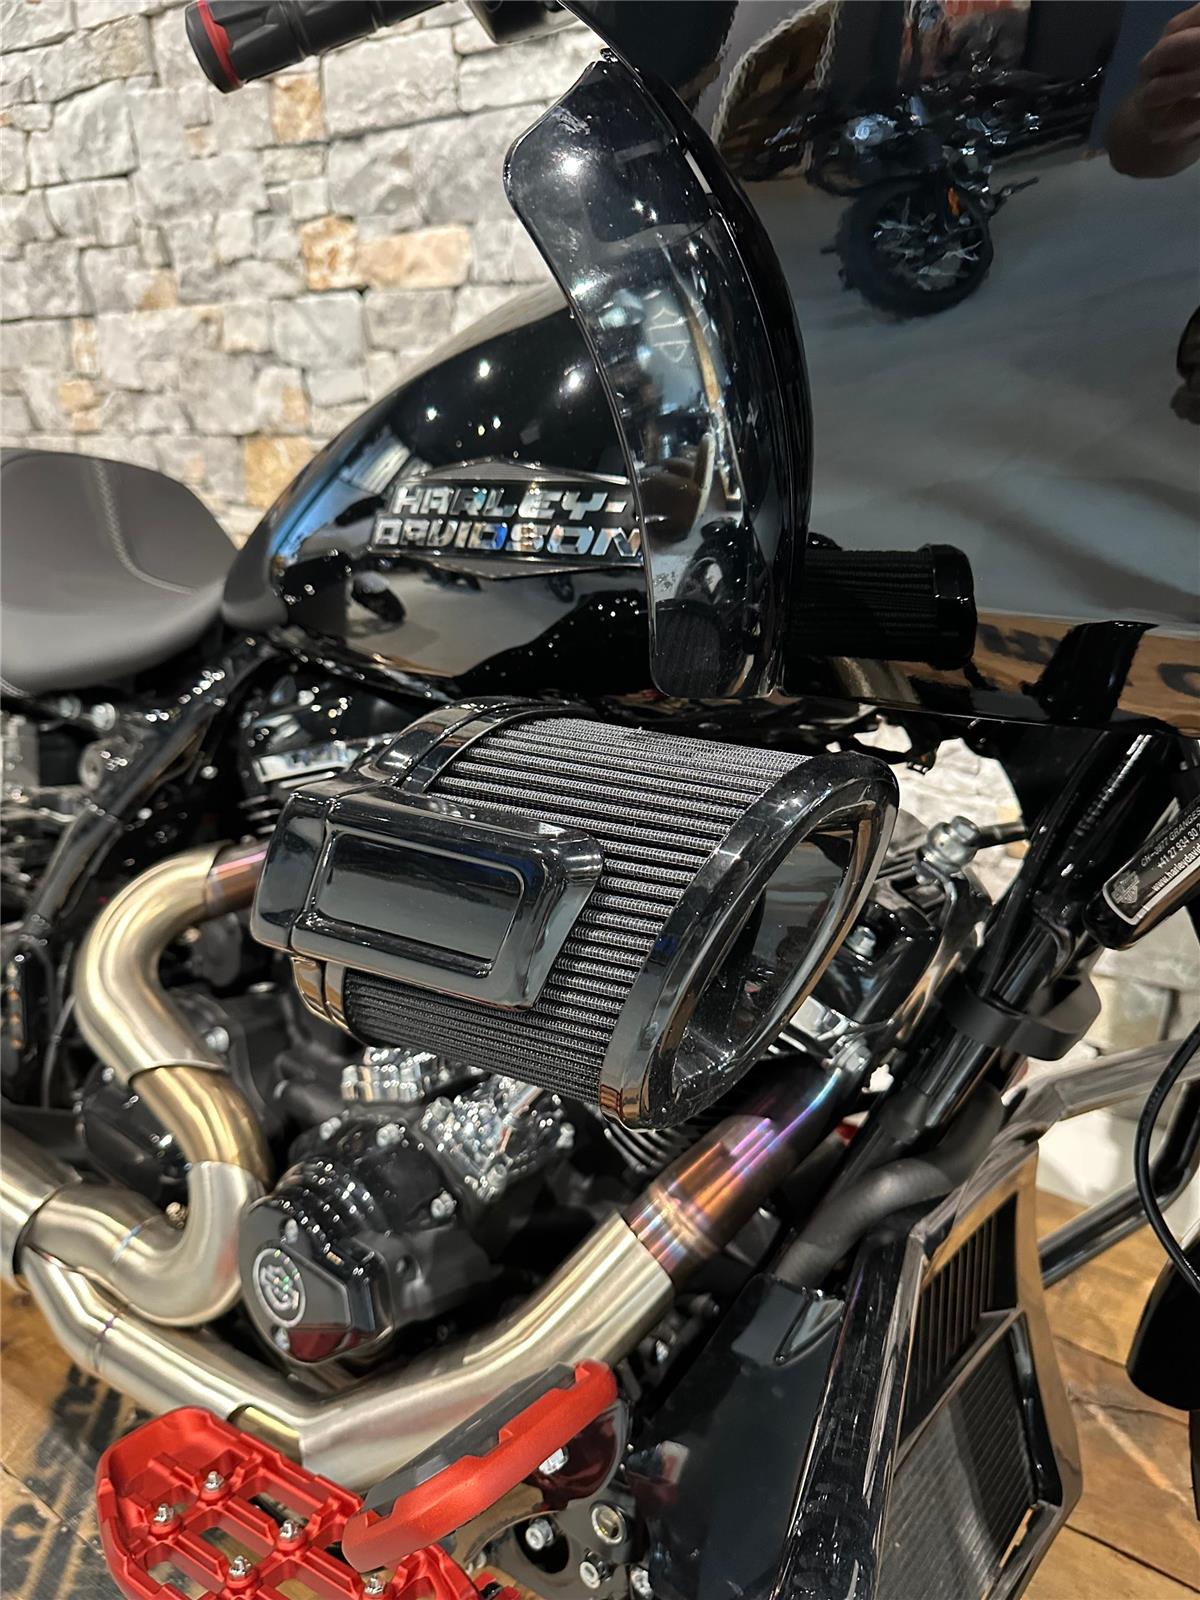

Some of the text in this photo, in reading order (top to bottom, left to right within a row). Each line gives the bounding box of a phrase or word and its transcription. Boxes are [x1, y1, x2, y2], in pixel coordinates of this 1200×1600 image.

[392, 486, 627, 520] HARLEY-
[372, 518, 641, 557] DAVIDSON
[1168, 846, 1178, 859] 27
[1176, 836, 1190, 851] 934
[1188, 827, 1199, 840] 30
